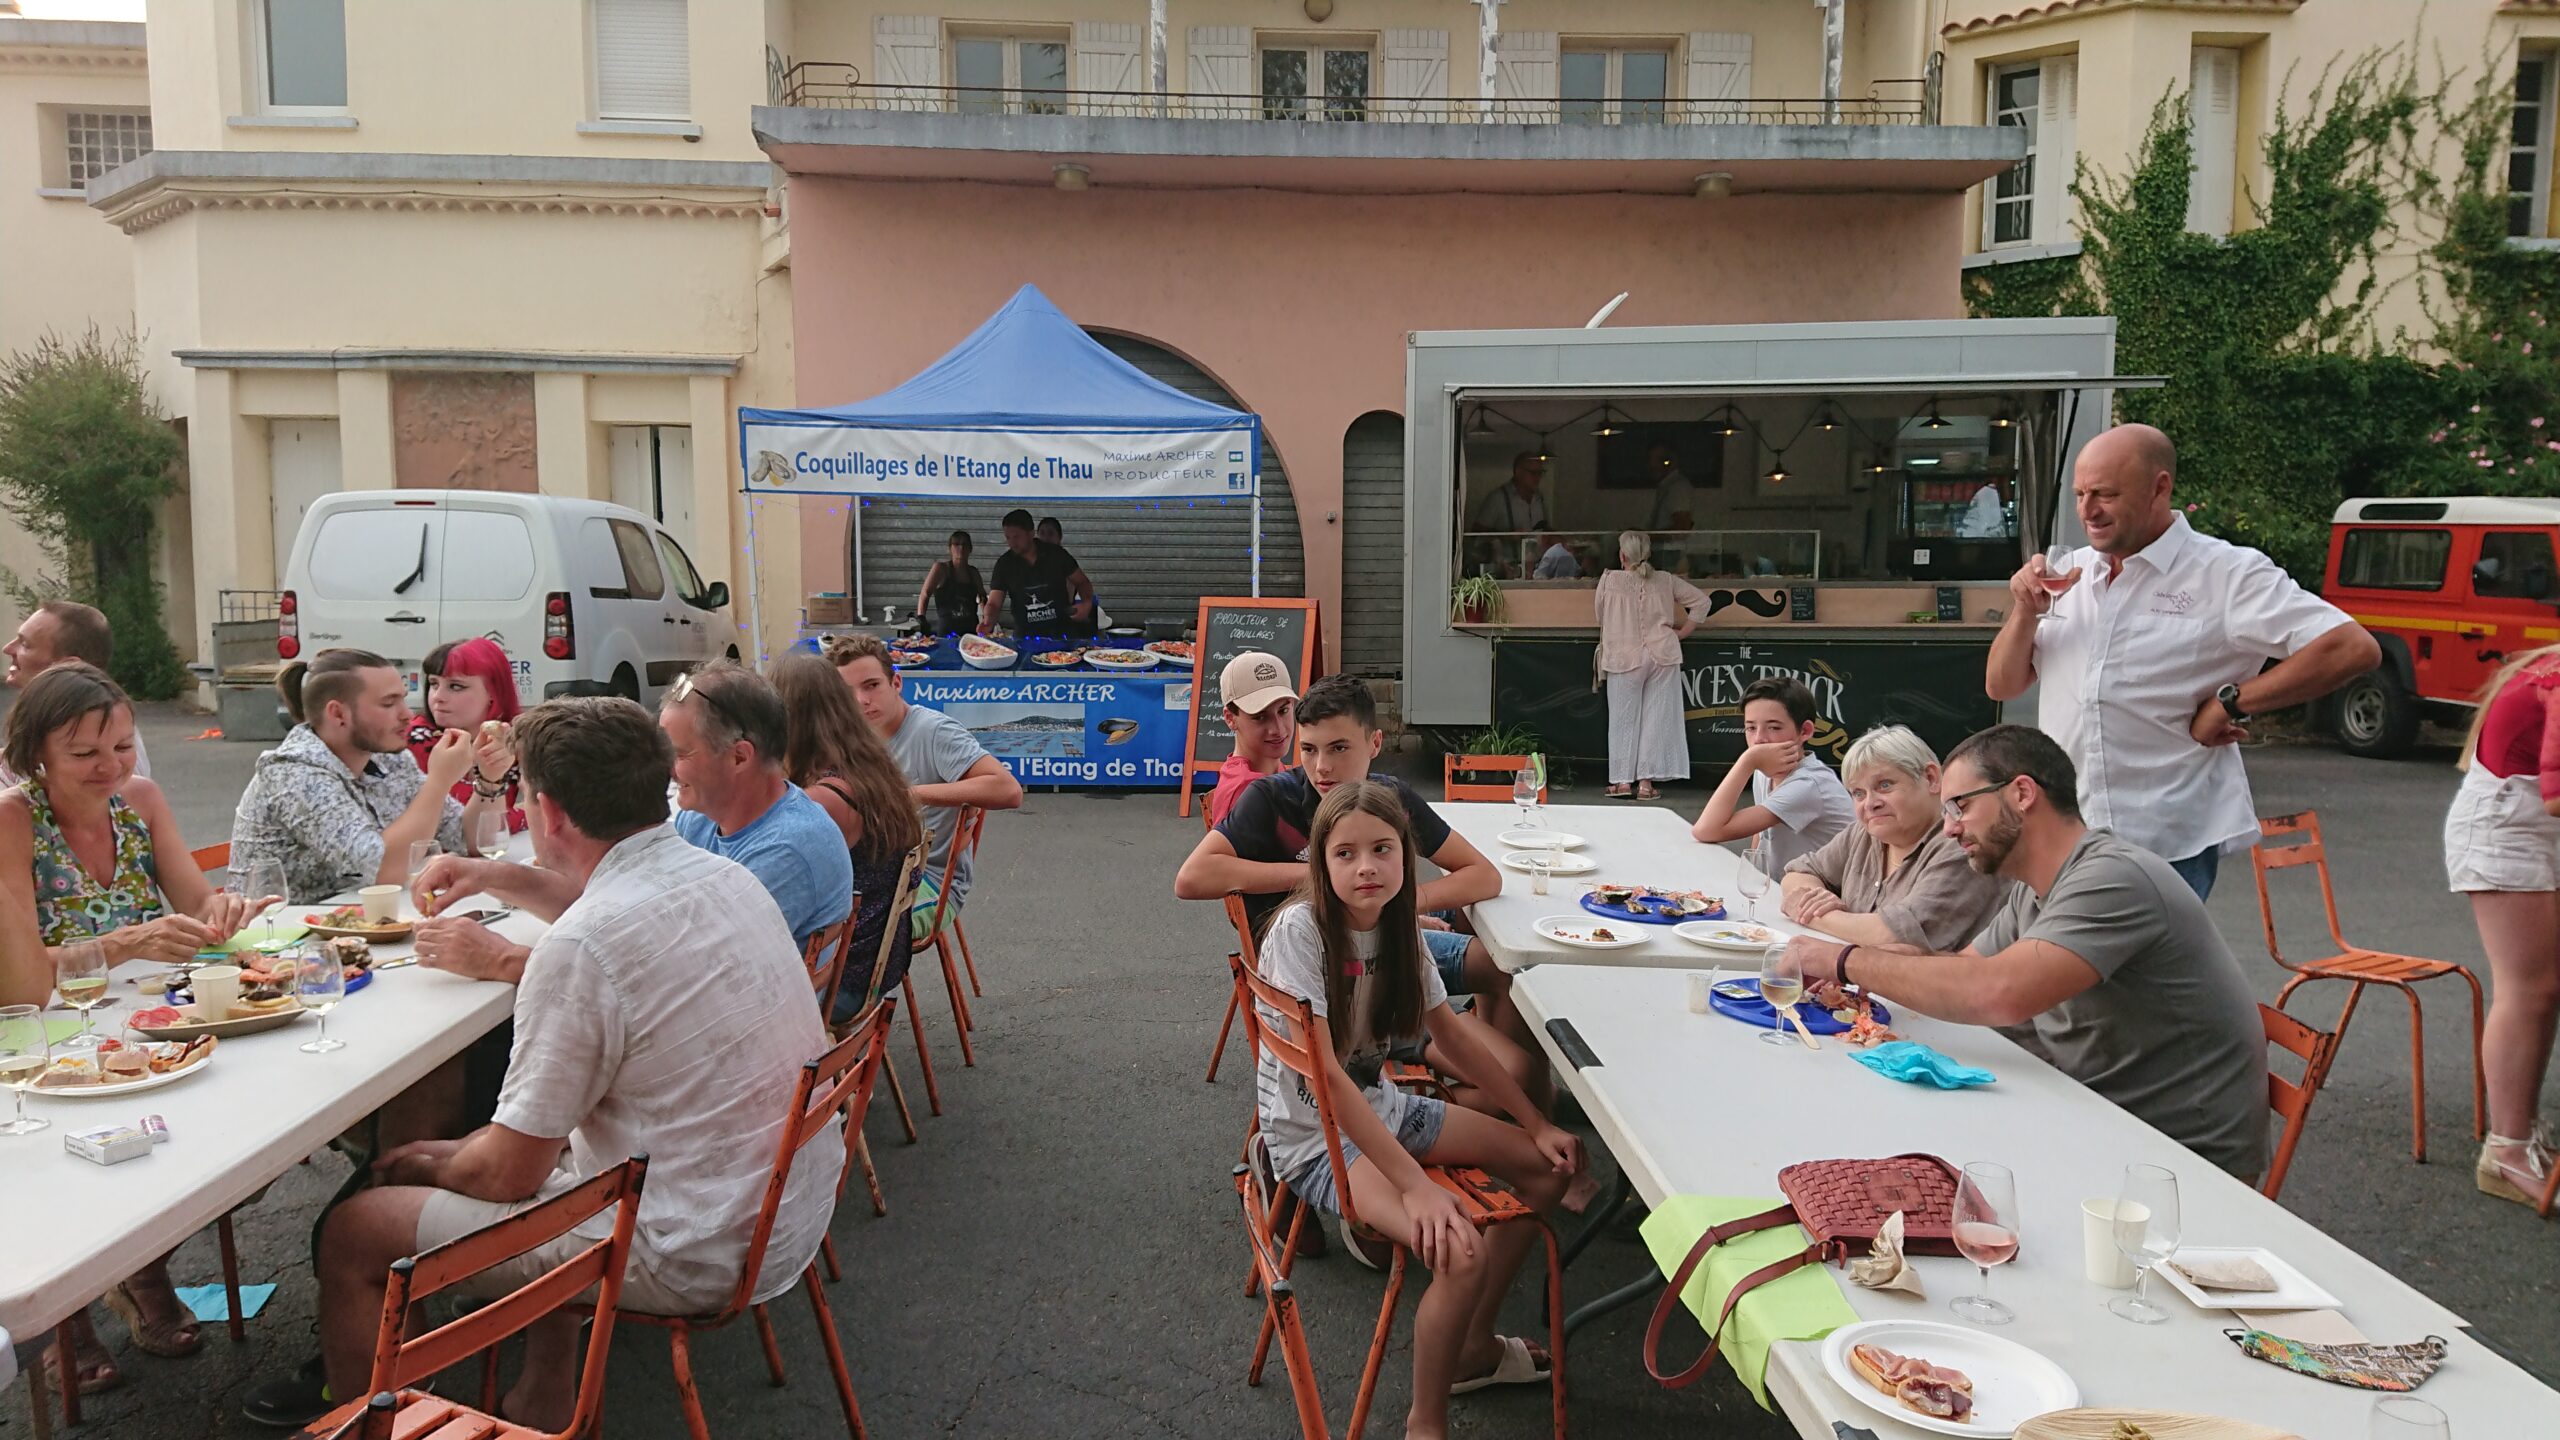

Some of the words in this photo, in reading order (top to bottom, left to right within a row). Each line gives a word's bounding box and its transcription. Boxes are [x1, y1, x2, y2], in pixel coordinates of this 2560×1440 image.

[1103, 451, 1152, 462] Maxime
[1155, 450, 1216, 461] ARCHER
[795, 451, 909, 481] Coquillages
[914, 454, 938, 477] de
[944, 454, 1011, 485] l'Etang
[1017, 456, 1040, 479] de
[1045, 456, 1093, 479] Thau
[1103, 469, 1217, 480] PRODUCTEUR
[1027, 608, 1056, 619] ARCHER
[1212, 612, 1268, 626] PRODUCTEUR
[1229, 628, 1275, 640] COQUILLAGES
[1739, 646, 1752, 660] THE
[914, 682, 1015, 702] Maxime
[1017, 683, 1117, 702] ARCHER
[1019, 758, 1098, 781] l'Etang
[1105, 758, 1137, 777] de
[1143, 758, 1196, 777] Tha
